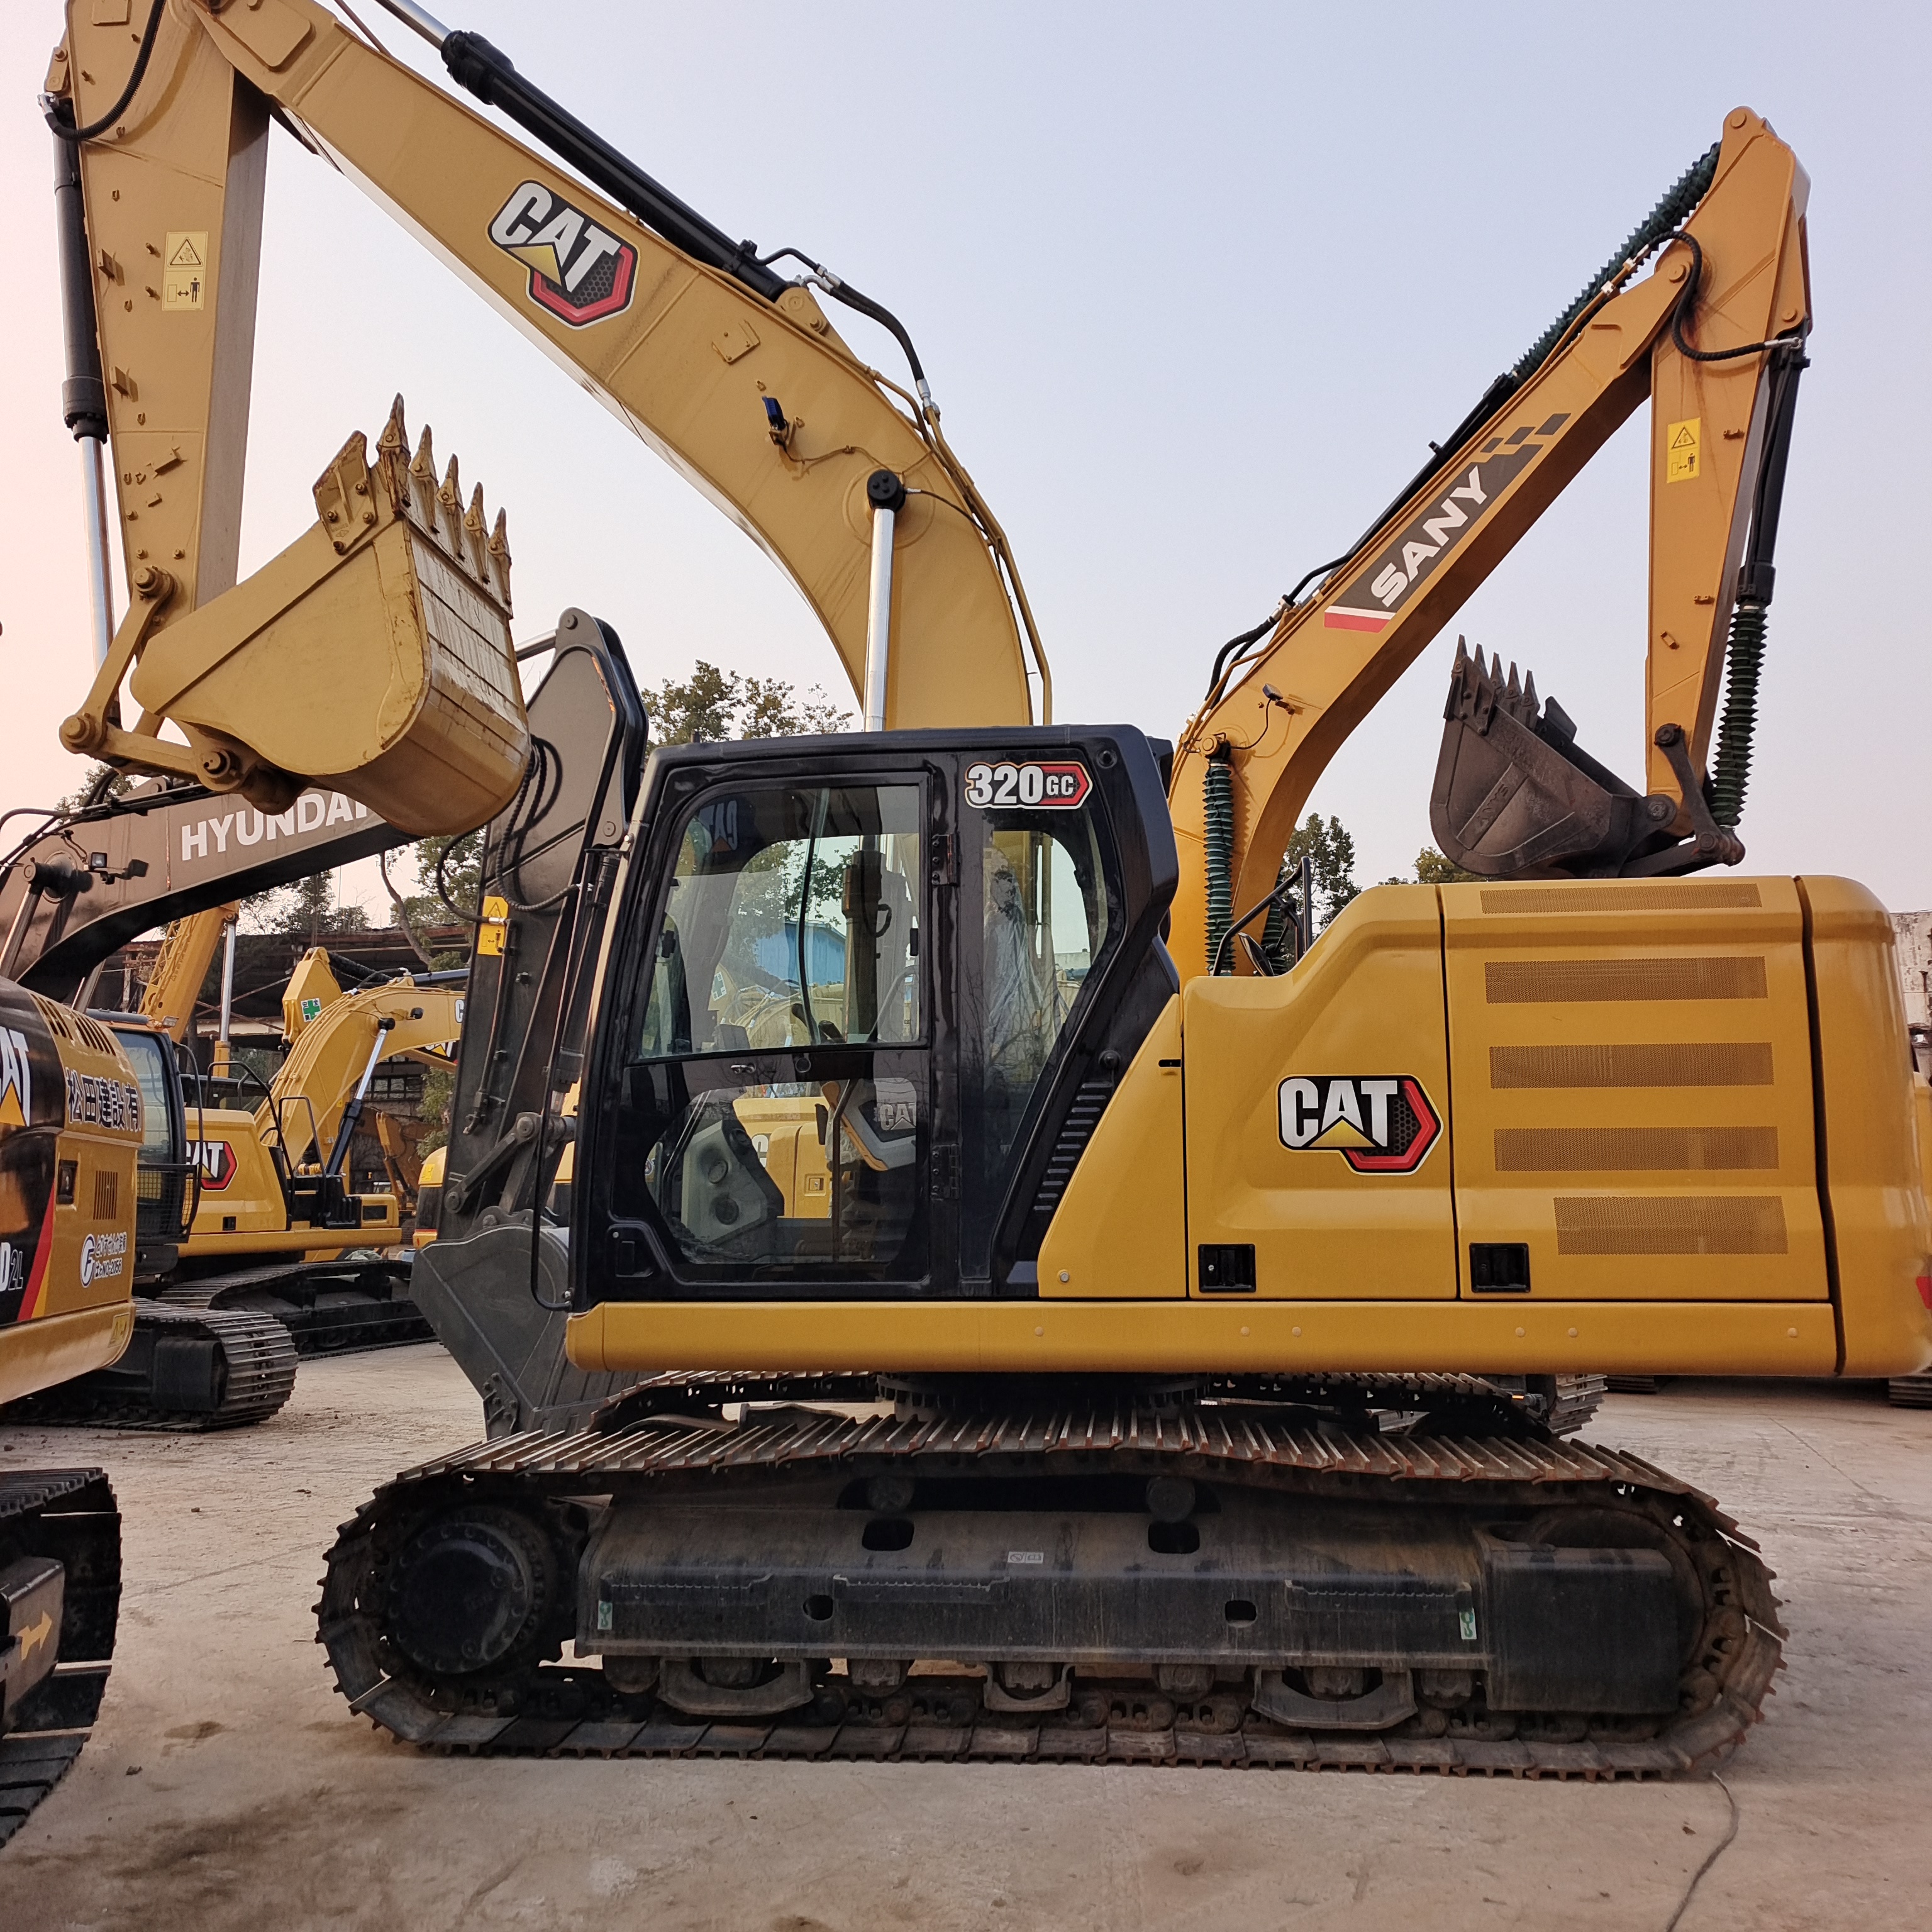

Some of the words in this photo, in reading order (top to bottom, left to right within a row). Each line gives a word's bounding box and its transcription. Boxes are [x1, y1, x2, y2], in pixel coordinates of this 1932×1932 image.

[491, 182, 621, 293] CAT
[1371, 465, 1487, 608] SANY
[969, 765, 1043, 804] 320
[1046, 775, 1074, 796] GC
[0, 1026, 30, 1127] AT
[1280, 1078, 1398, 1147] CAT
